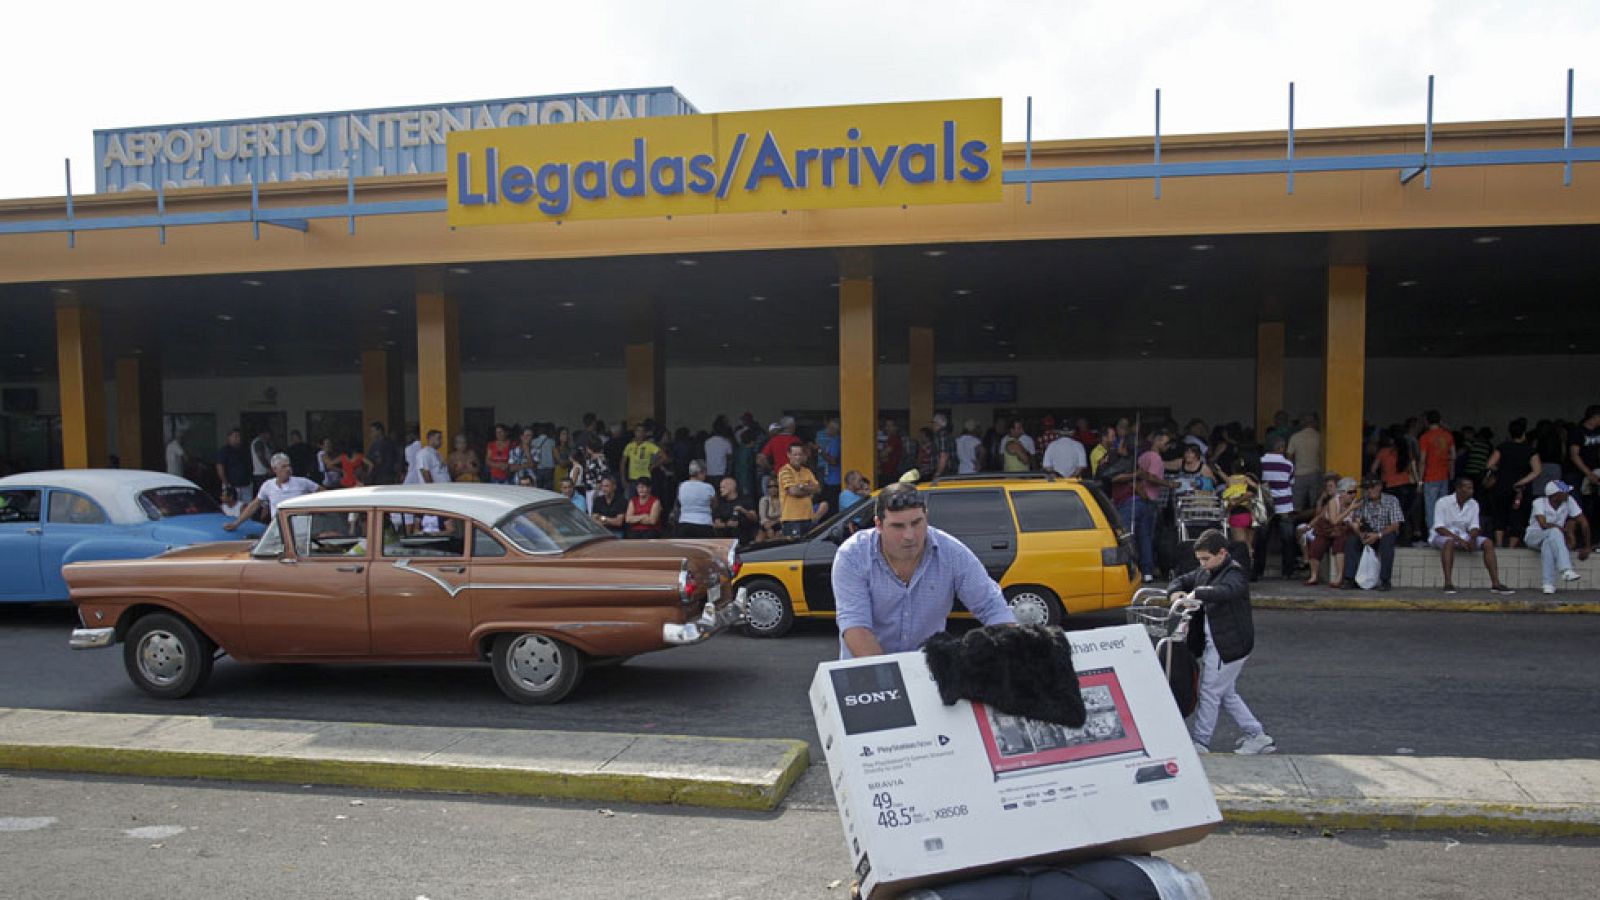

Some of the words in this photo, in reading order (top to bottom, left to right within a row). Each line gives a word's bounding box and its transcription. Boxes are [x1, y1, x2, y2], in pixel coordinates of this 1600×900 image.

[104, 119, 326, 168] AEROPUERTO
[457, 120, 991, 216] Llegadas/Arrivals
[845, 689, 899, 707] SONY
[868, 779, 904, 790] BRAVIA
[873, 792, 892, 809] 49
